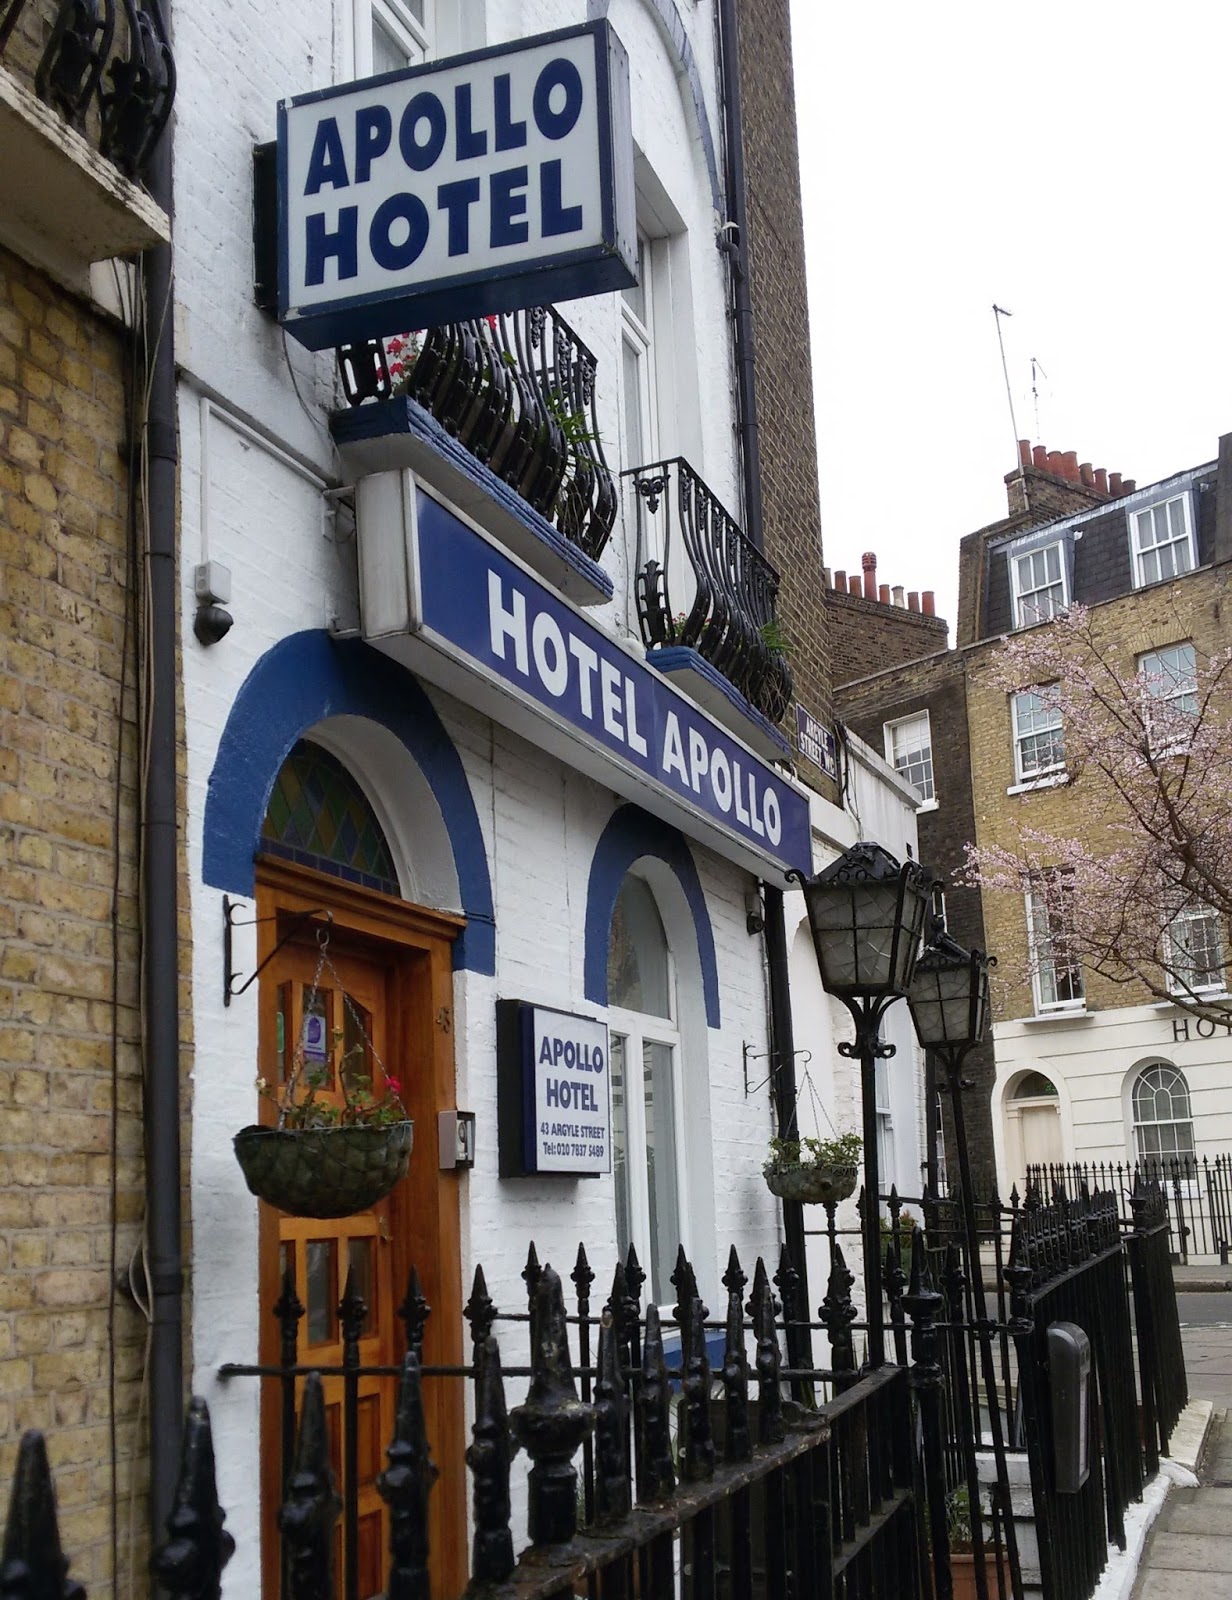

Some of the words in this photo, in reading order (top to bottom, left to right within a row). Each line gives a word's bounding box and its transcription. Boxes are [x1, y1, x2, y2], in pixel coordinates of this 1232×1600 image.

[303, 57, 583, 196] APOLLO
[304, 158, 583, 287] HOTEL
[487, 568, 648, 758] HOTEL
[662, 710, 781, 847] APOLLO
[805, 716, 829, 752] ARGYLE
[539, 1036, 604, 1074] APOLLO
[546, 1078, 599, 1112] HOTEL
[540, 1122, 549, 1136] 43
[551, 1122, 579, 1138] ARGYLE
[581, 1125, 605, 1139] STREET
[571, 1143, 587, 1157] 7837
[588, 1144, 604, 1158] 5489
